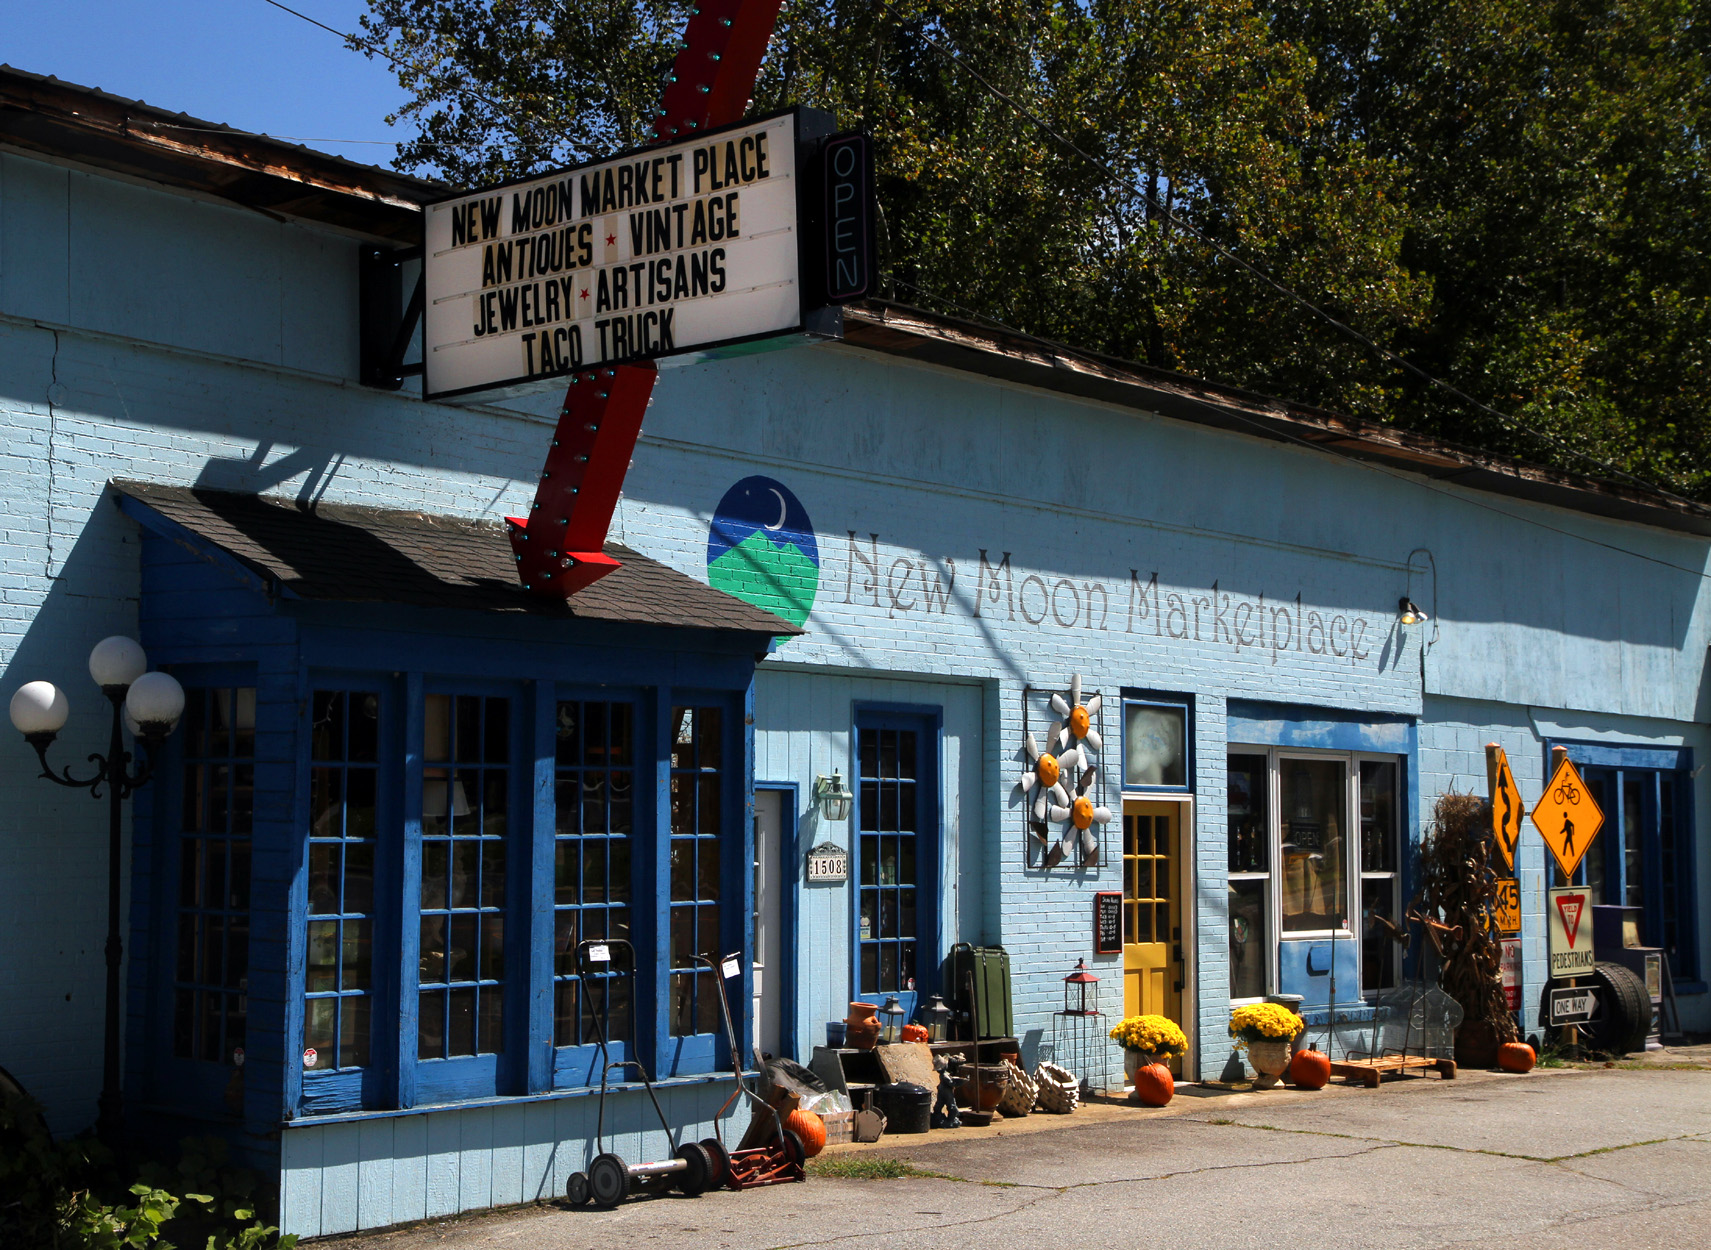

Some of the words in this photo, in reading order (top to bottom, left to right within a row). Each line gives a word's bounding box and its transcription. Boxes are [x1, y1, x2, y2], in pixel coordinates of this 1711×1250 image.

[452, 196, 502, 247] NEW
[512, 178, 573, 234] MOON
[580, 154, 682, 217] MARKET
[693, 131, 770, 194] PLACE
[834, 145, 858, 290] OPEN
[482, 223, 593, 287] ANTIQUES
[629, 192, 740, 256] VINTAGE
[474, 275, 573, 336] JEWELRY
[596, 248, 726, 313] ARTISANS
[522, 324, 583, 376] TACO
[595, 308, 675, 361] TRUCK
[842, 530, 956, 619] New
[973, 548, 1108, 630] Moon
[1126, 569, 1369, 666] Marketplace
[1295, 831, 1320, 846] OPEN
[814, 859, 842, 875] 1508
[1500, 885, 1518, 910] 45
[1564, 905, 1578, 913] YIELD
[1568, 915, 1575, 925] TO
[1505, 944, 1516, 958] NO
[1552, 950, 1593, 969] PEDESTRIANS
[1556, 1000, 1570, 1014] ONE
[1571, 998, 1587, 1012] WAY
